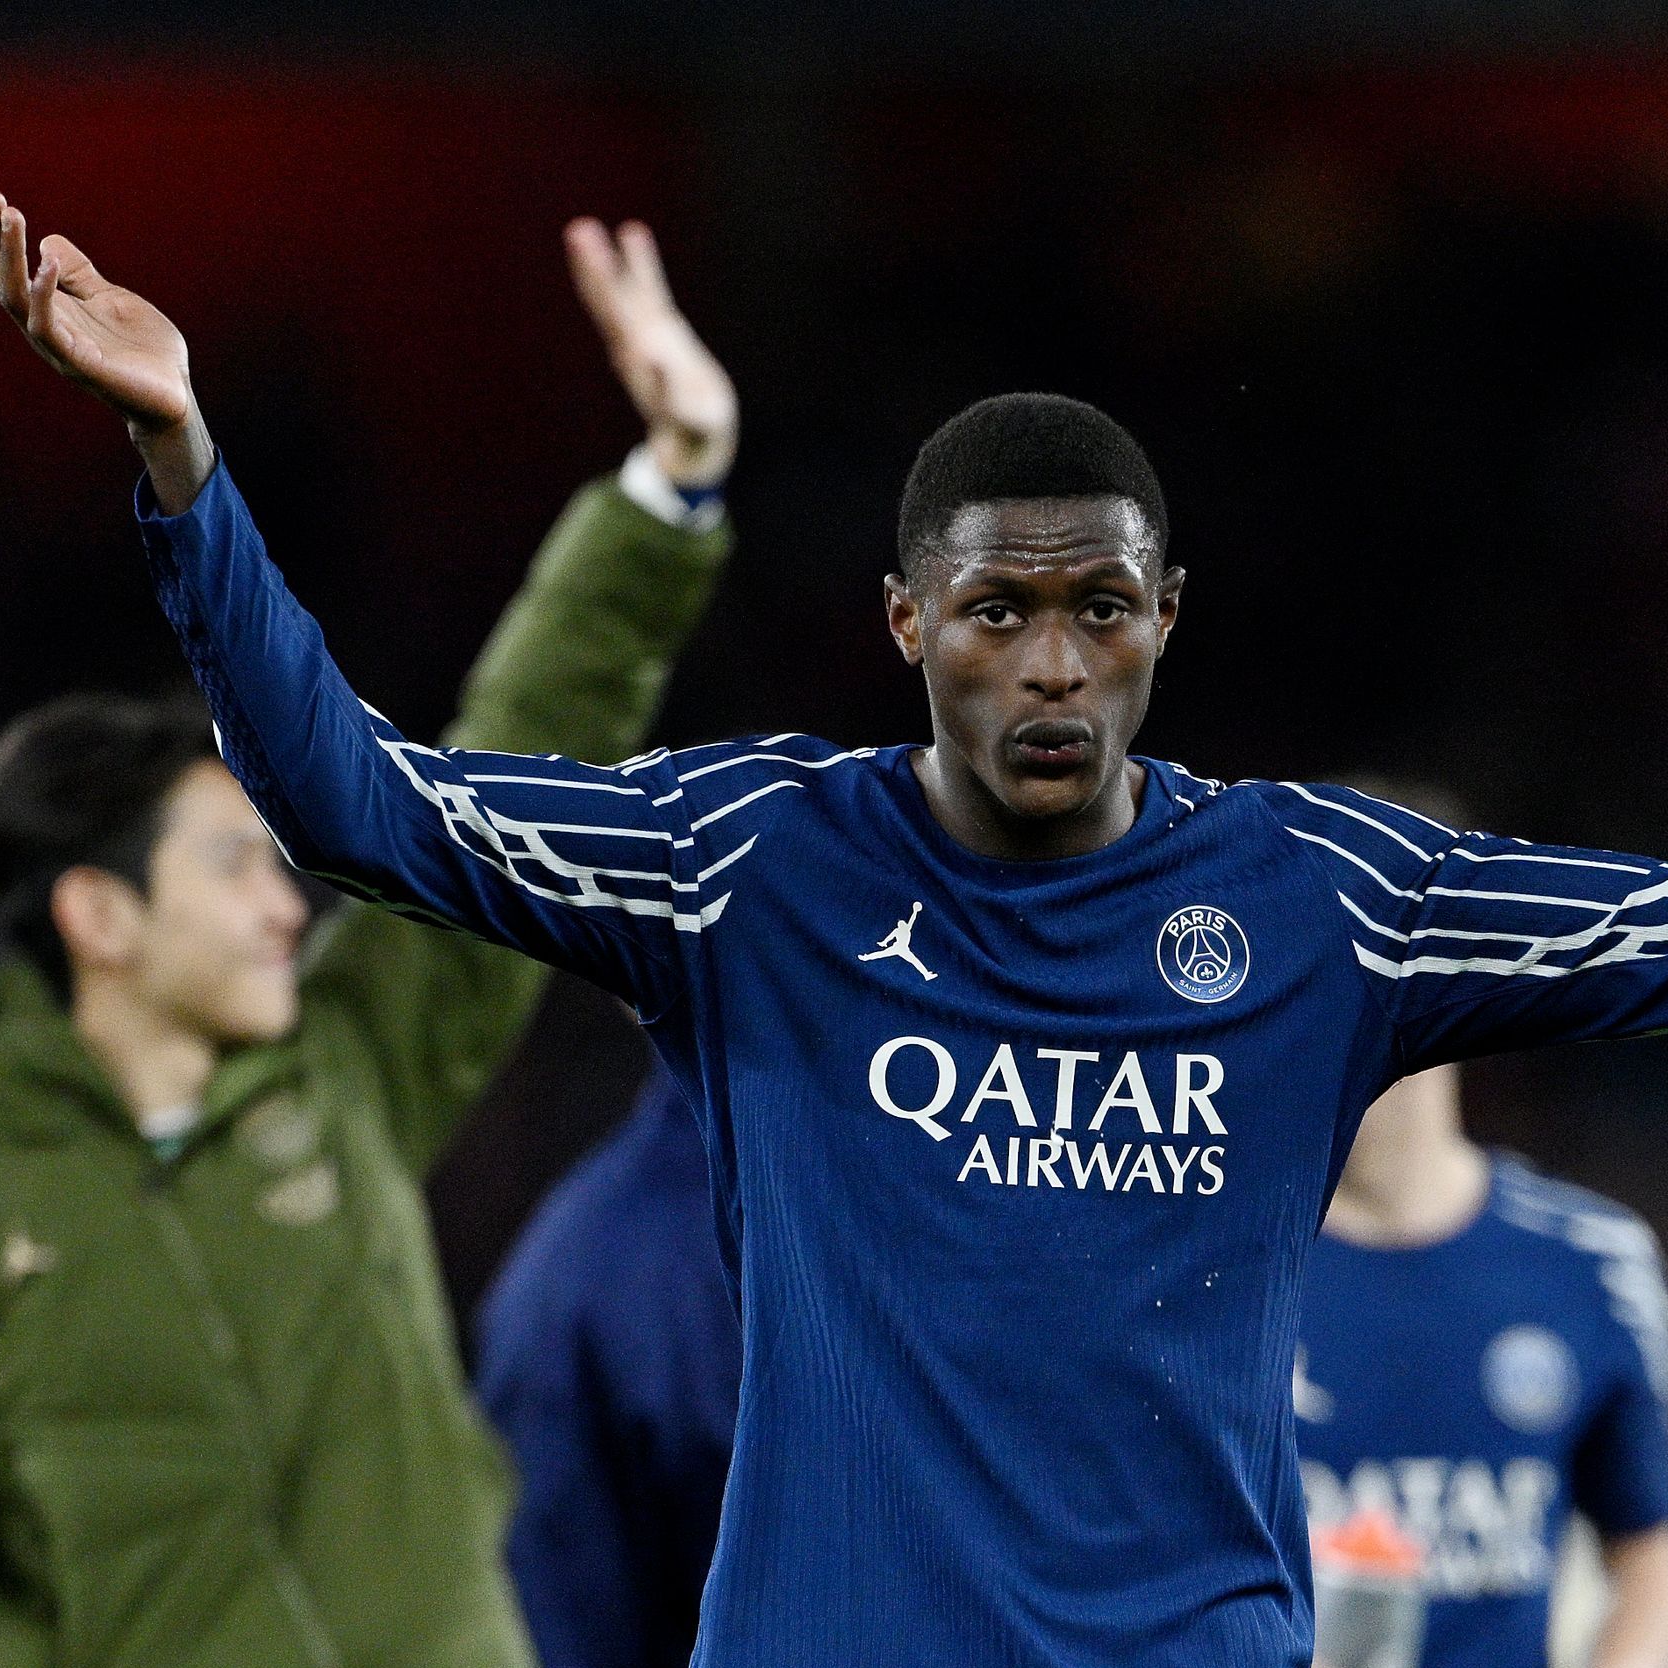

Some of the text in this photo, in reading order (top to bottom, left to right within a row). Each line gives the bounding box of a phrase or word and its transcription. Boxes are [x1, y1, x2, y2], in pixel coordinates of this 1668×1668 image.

[1167, 910, 1227, 938] PARIS
[867, 1035, 1229, 1142] QATAR
[957, 1135, 1225, 1195] AIRWAYS
